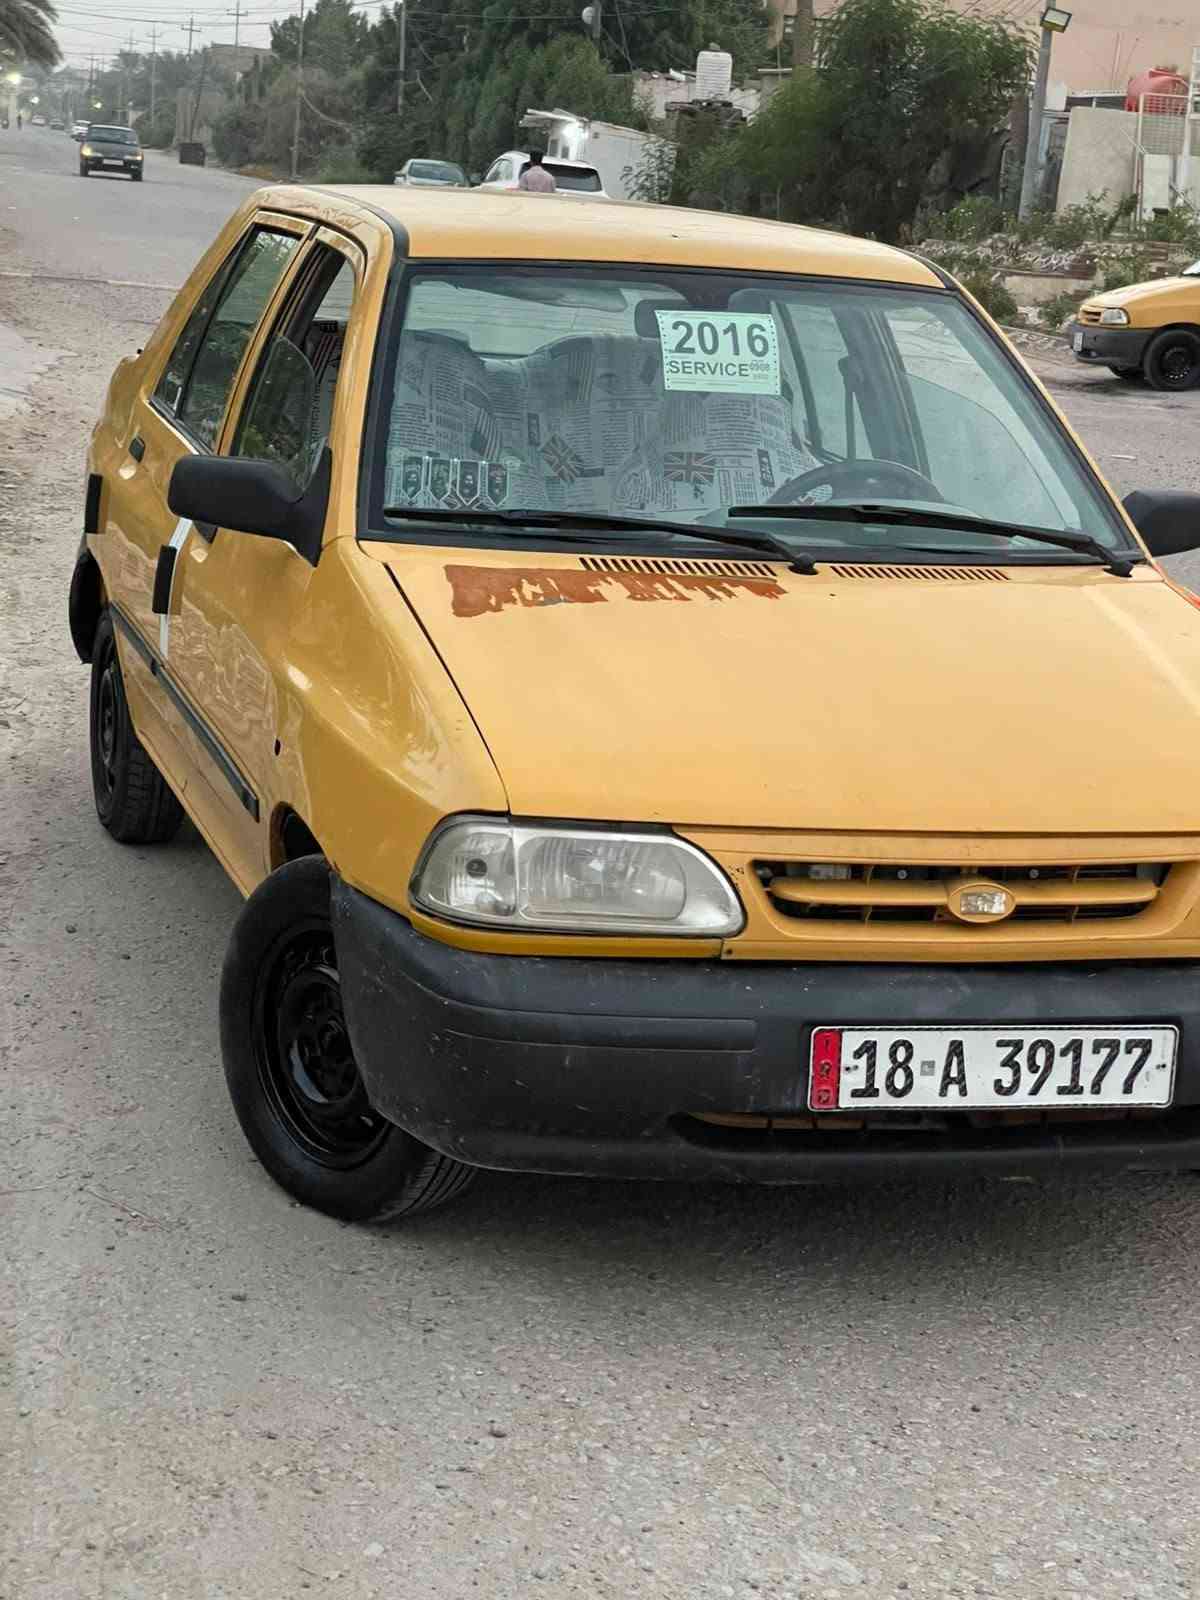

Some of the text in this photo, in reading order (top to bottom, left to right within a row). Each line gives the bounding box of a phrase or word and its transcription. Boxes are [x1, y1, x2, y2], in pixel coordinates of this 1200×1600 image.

[672, 320, 770, 357] 2016
[669, 360, 750, 377] SERVICE
[850, 1038, 1153, 1098] 18 A 39177
